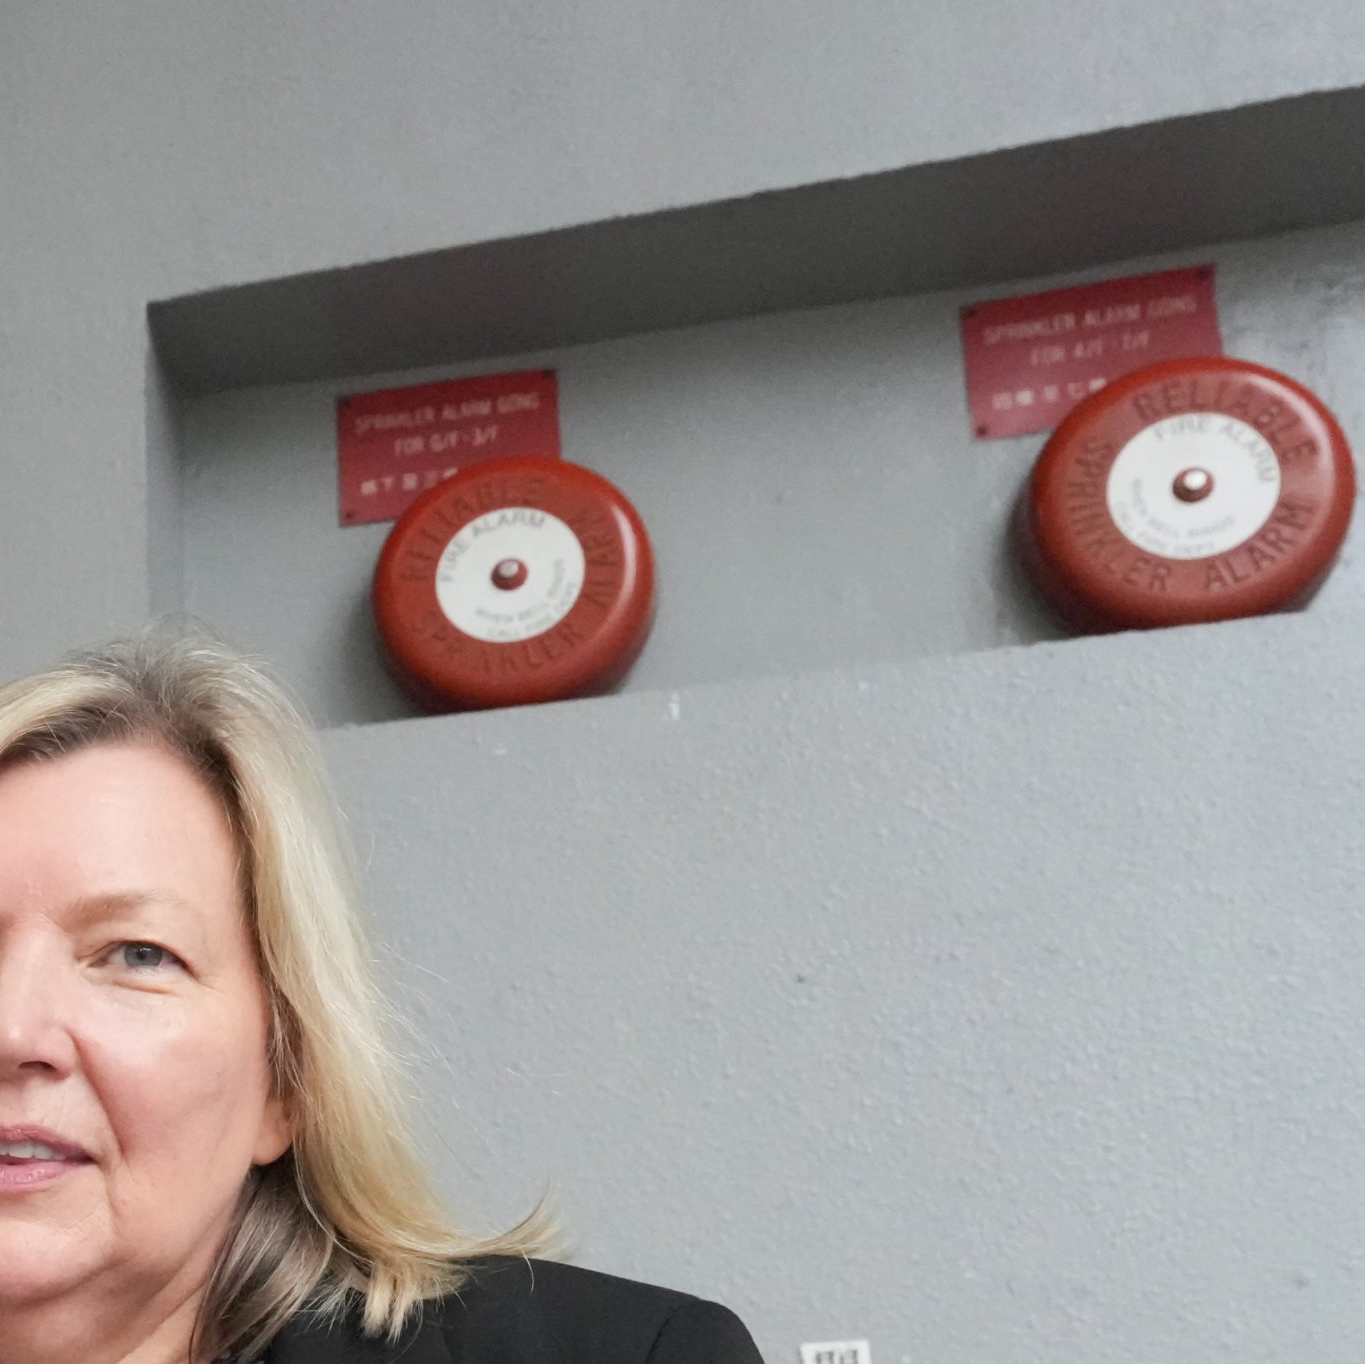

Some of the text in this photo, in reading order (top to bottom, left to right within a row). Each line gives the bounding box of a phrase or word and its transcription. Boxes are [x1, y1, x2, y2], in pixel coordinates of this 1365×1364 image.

[442, 399, 493, 422] ALARM
[1133, 379, 1317, 465] RELIABLE
[394, 433, 425, 457] FOR
[1156, 418, 1276, 484] FIRE ALARM
[471, 511, 547, 538] ALARM
[1204, 499, 1314, 591] ALARM
